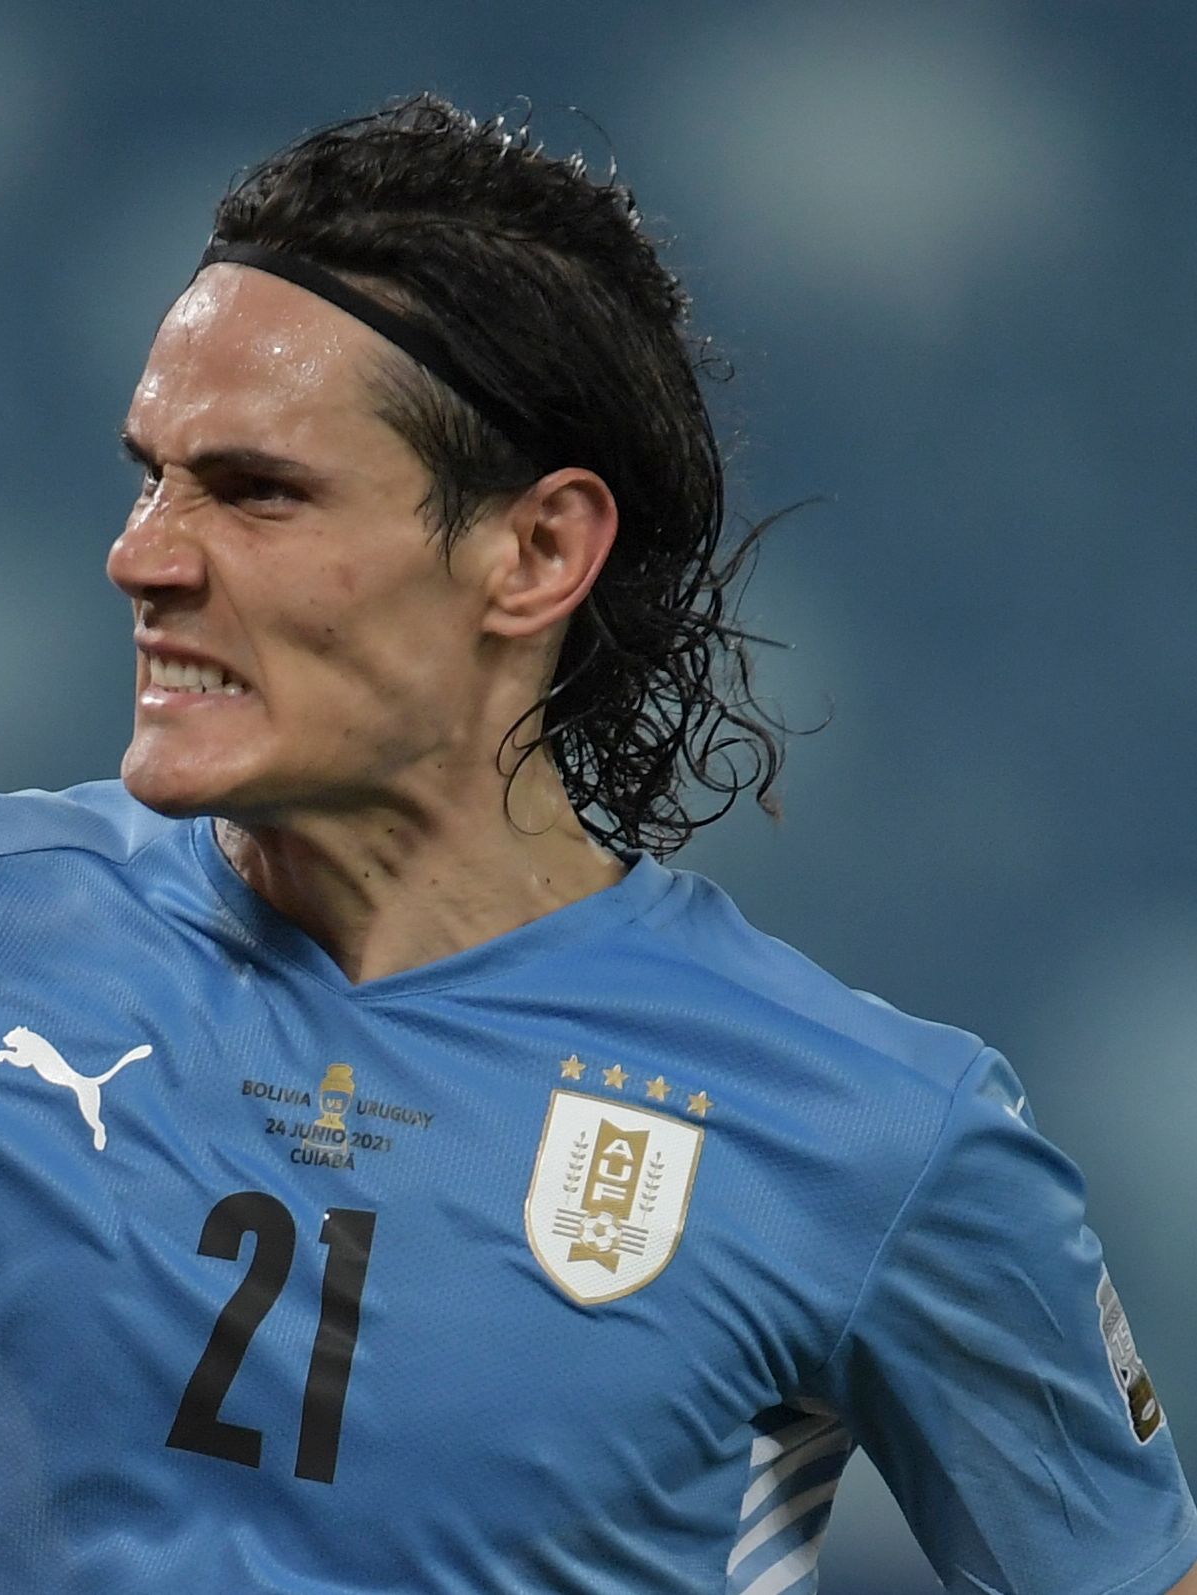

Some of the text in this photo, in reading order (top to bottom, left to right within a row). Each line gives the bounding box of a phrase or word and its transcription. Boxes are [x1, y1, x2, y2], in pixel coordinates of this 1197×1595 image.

[242, 1080, 311, 1107] BOLIVIA
[357, 1100, 435, 1129] URUGUAY
[265, 1118, 392, 1152] 24 JUNIO 2021
[165, 1191, 377, 1484] 21
